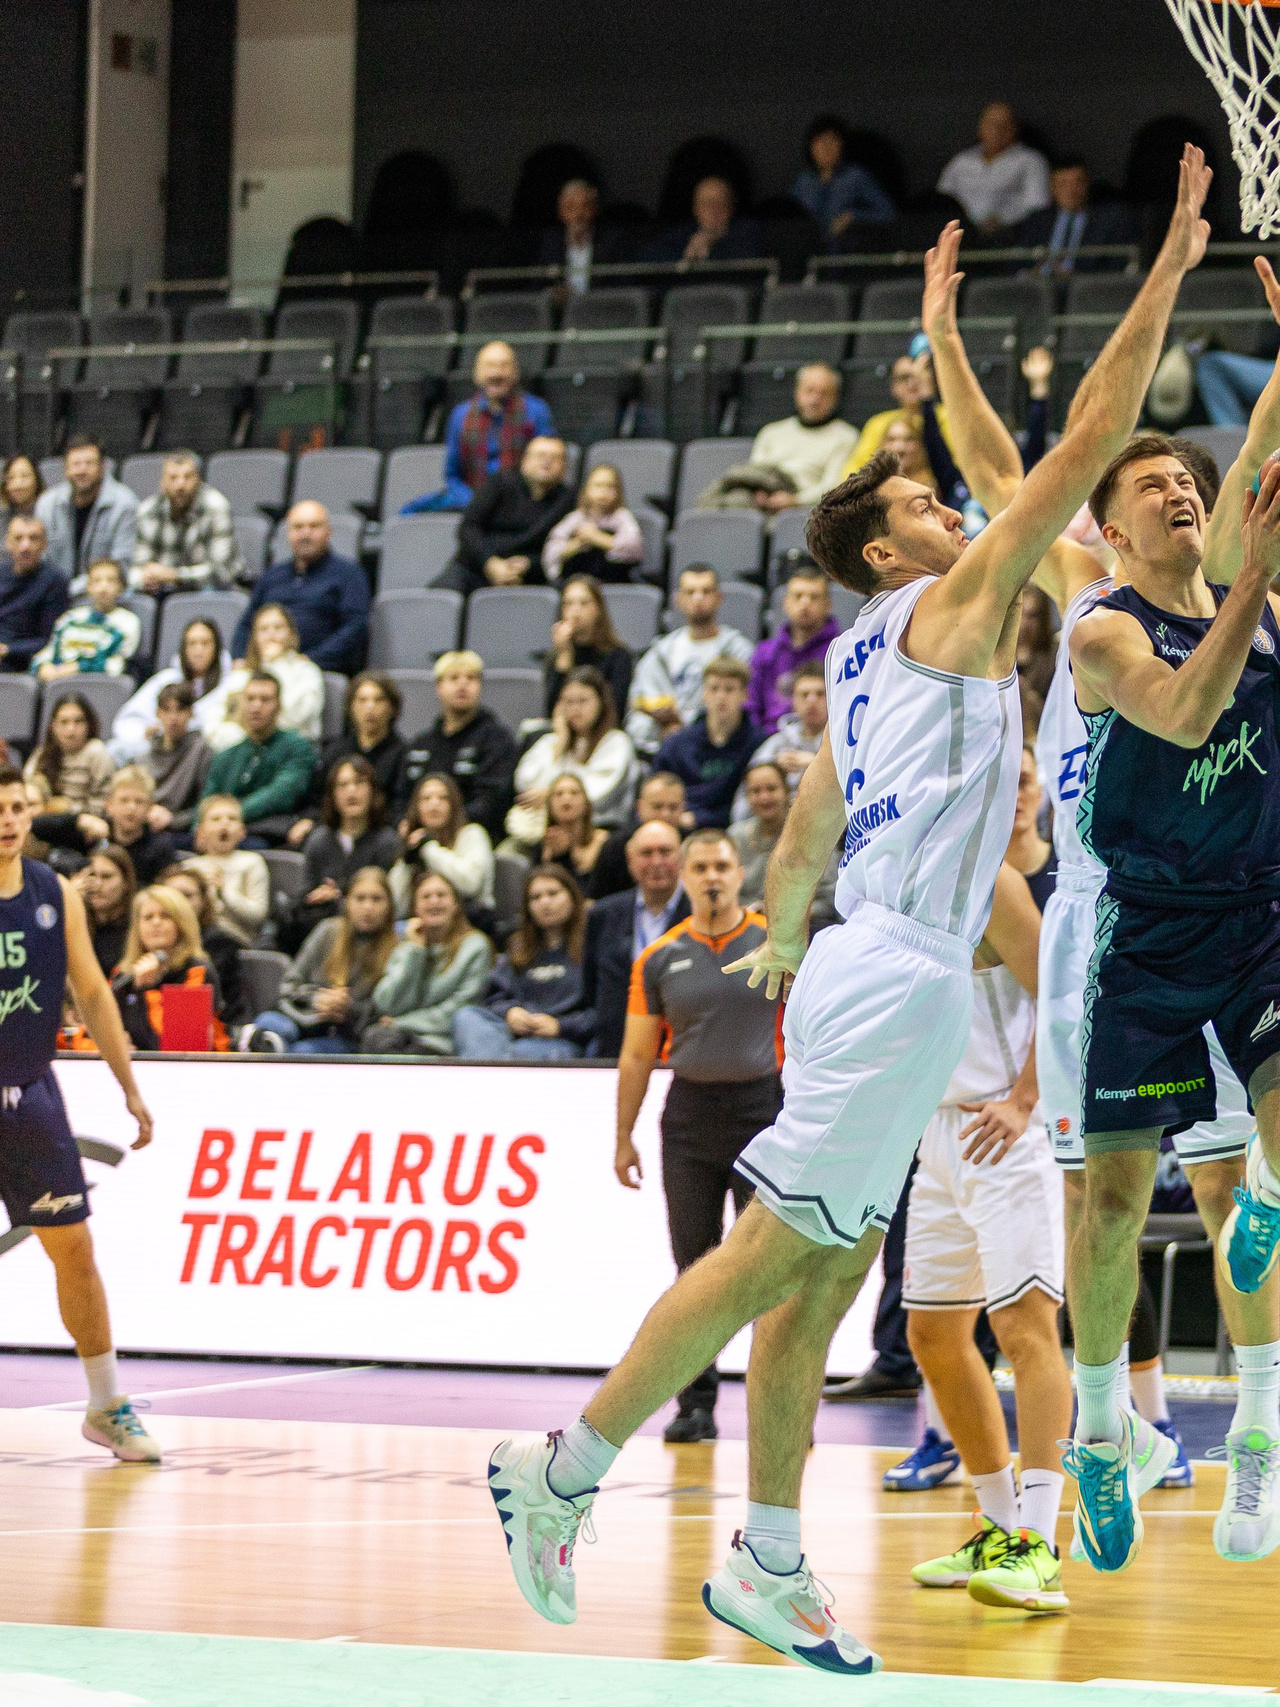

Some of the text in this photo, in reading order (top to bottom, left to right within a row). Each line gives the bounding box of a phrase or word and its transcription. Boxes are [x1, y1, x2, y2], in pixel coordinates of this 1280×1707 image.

[1095, 1088, 1137, 1102] Kempa
[187, 1128, 546, 1208] BELARUS
[179, 1212, 527, 1295] TRACTORS
